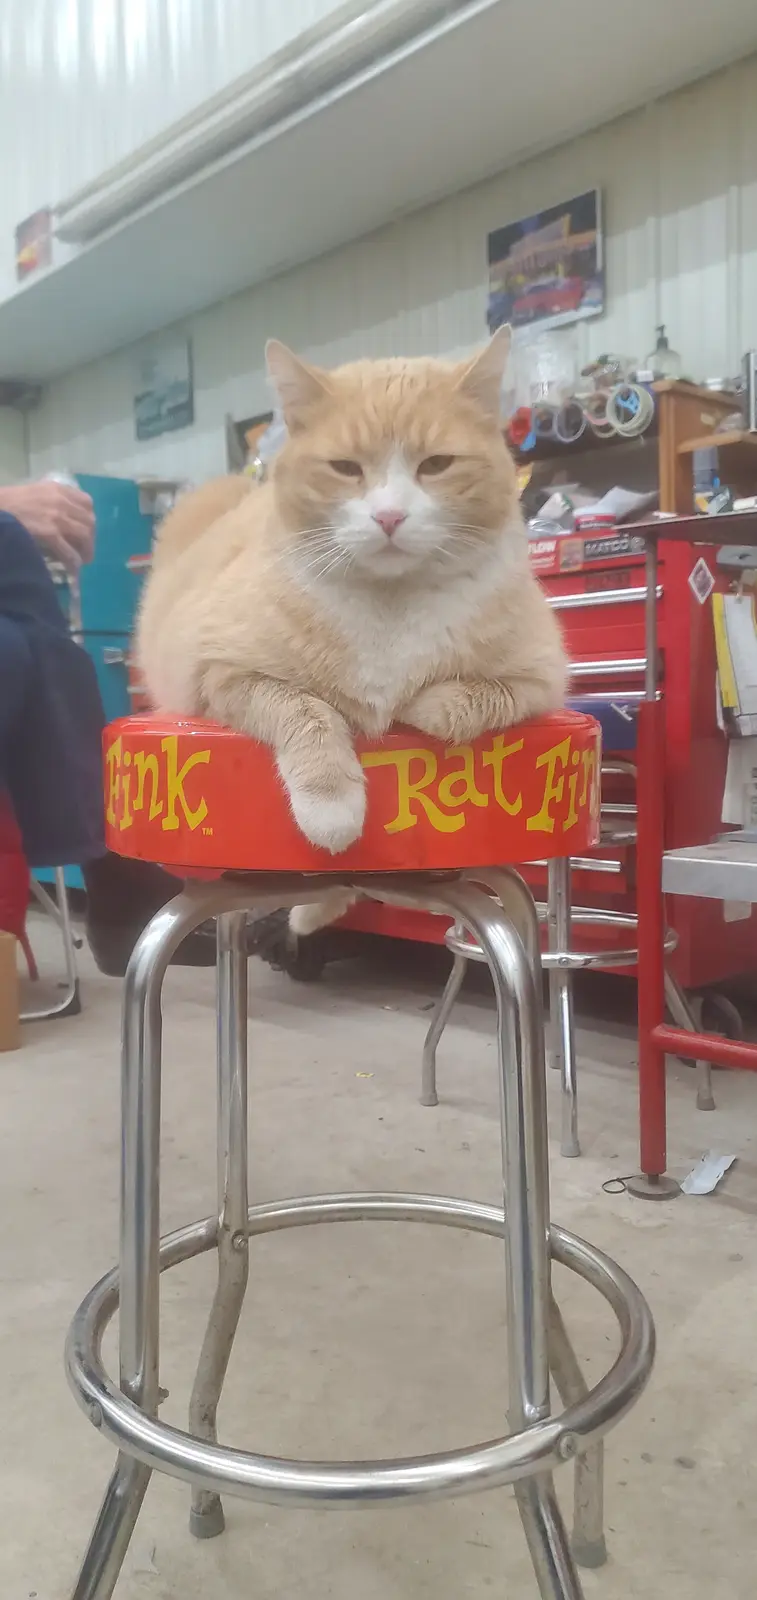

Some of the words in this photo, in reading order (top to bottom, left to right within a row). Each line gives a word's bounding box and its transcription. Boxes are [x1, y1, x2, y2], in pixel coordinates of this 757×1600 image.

[106, 735, 211, 831] Fink
[361, 735, 524, 833] Rat
[526, 735, 599, 833] Fin
